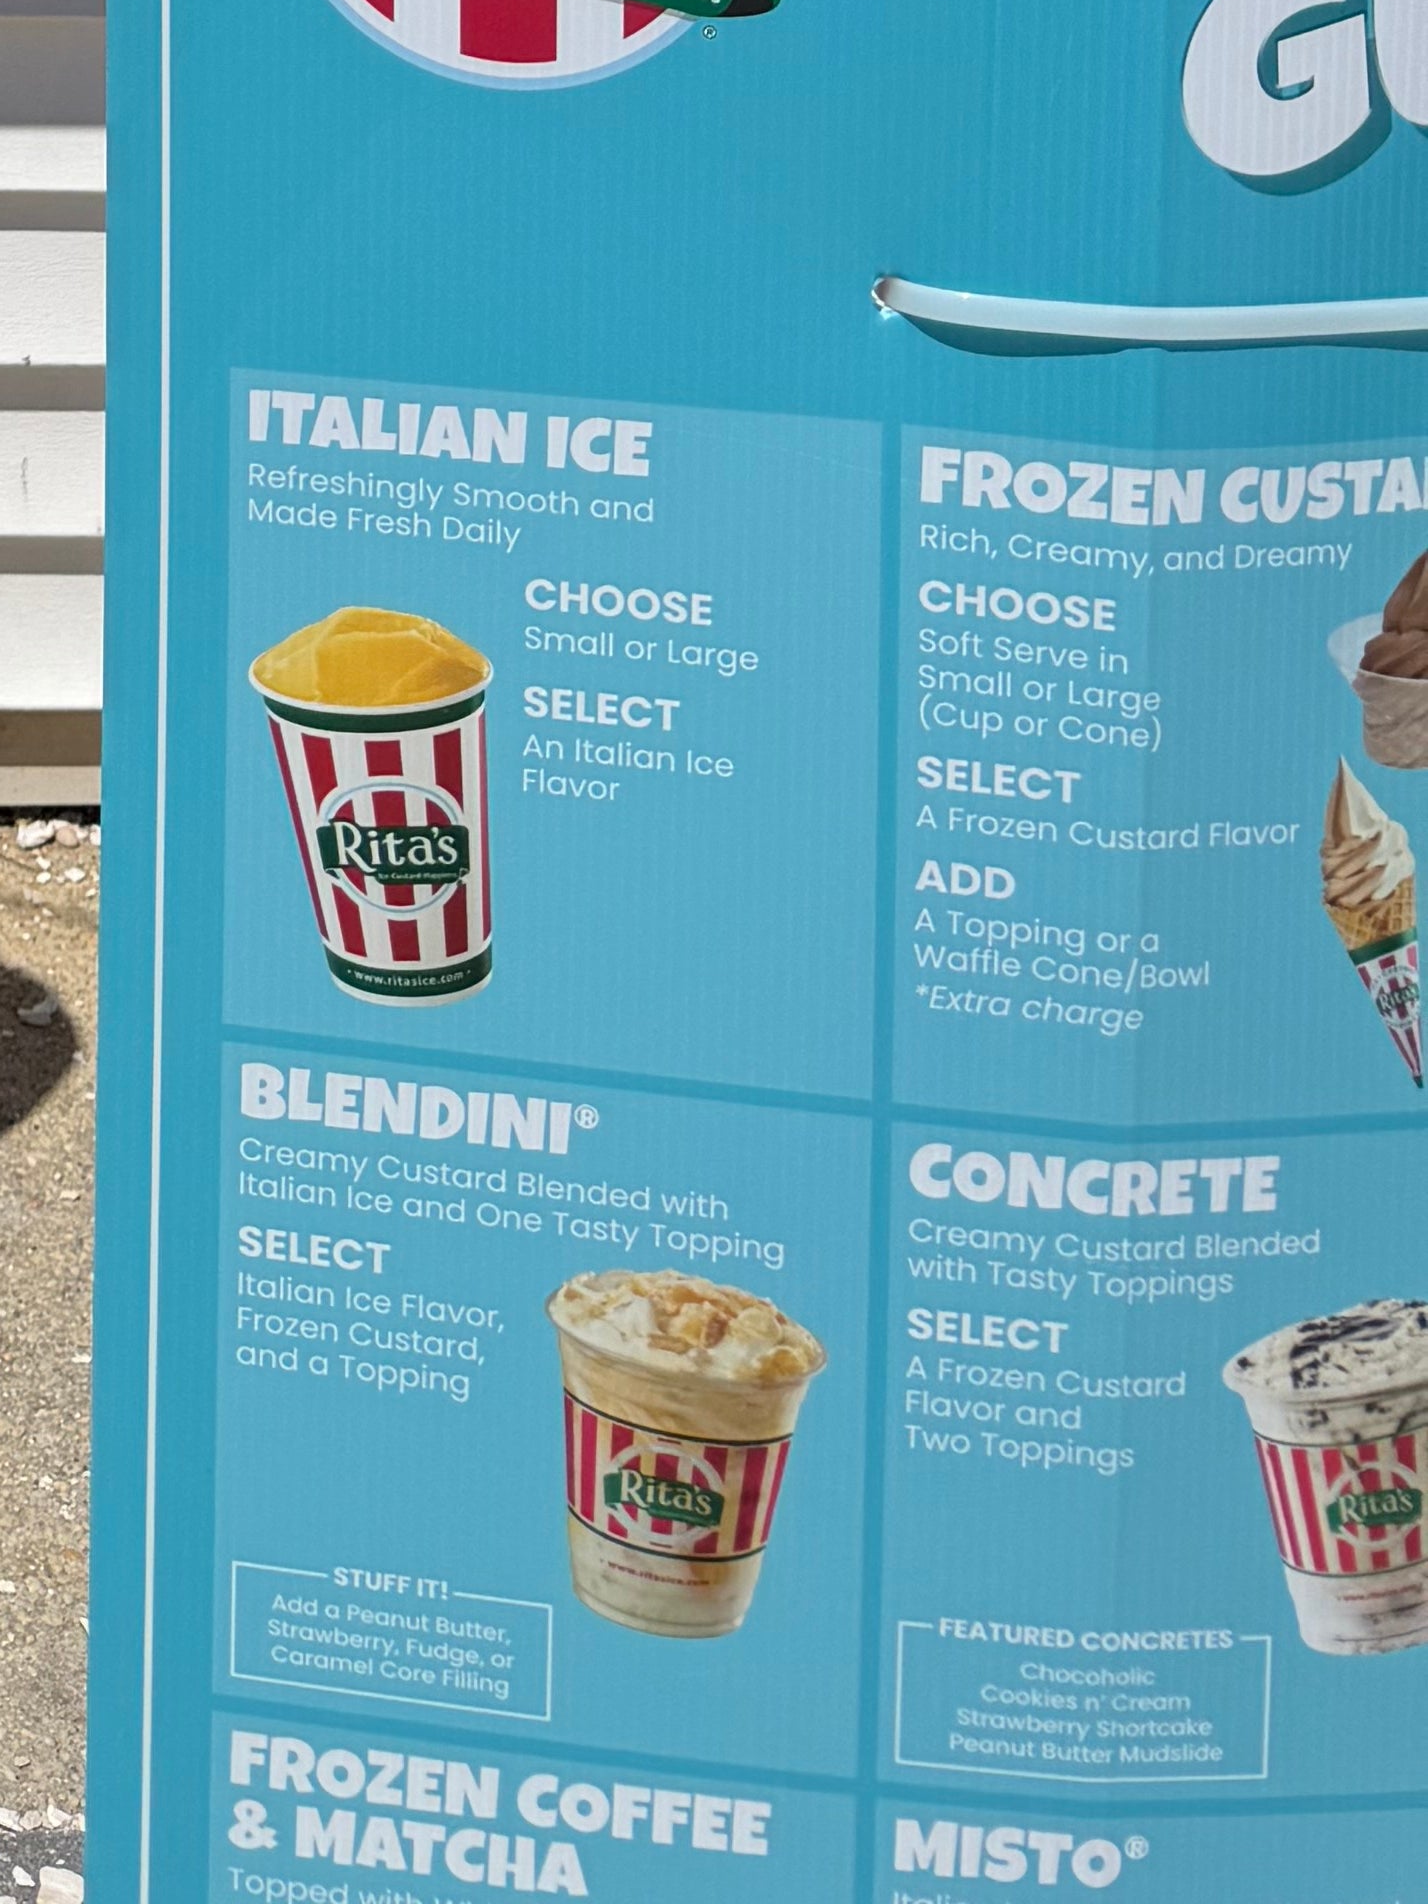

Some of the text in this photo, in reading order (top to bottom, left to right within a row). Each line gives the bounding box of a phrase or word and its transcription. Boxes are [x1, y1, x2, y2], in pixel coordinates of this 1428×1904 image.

[248, 390, 653, 476] ITALIAN ICE
[248, 464, 654, 522] Refreshingly Smooth and
[921, 446, 1428, 525] FROZEN CUSTA
[248, 499, 521, 553] Made Fresh Daily
[920, 525, 1352, 578] Rich, Creamy, and Dreamy
[524, 579, 712, 626] CHOOSE
[918, 580, 1116, 632] CHOOSE
[524, 626, 759, 676] Small or Large
[523, 686, 680, 731] SELECT
[917, 756, 1081, 803] SELECT
[334, 822, 458, 873] Rita's
[915, 860, 1016, 899] ADD
[914, 944, 1210, 993] Waffle Cone/Bowl
[1021, 994, 1143, 1037] charge
[239, 1138, 729, 1221] Creamy Custard Blended with
[909, 1143, 1280, 1217] CONCRETE
[239, 1171, 785, 1270] Italian Ice and One Tasty Topping
[908, 1218, 1320, 1262] Creamy Custard Blended
[238, 1226, 391, 1274] SELECT
[908, 1256, 1234, 1305] with Tasty Toppings
[907, 1308, 1069, 1354] SELECT
[621, 1469, 712, 1515] Rita's
[334, 1567, 449, 1600] STUFF IT!
[268, 1619, 514, 1668] Strawberry, Fudge, or
[272, 1594, 511, 1645] Add a Peanut Butter,
[940, 1618, 1233, 1652] FEATURED CONCRETES
[271, 1645, 509, 1700] Caramel Core Filling
[1020, 1662, 1156, 1686] Chocoholic
[981, 1684, 1077, 1710] Cookies
[1112, 1694, 1191, 1711] Cream
[949, 1733, 1223, 1764] Peanut Butter Mudslide
[956, 1708, 1213, 1742] Strawberry Shortcake
[228, 1730, 772, 1855] FROZEN COFFEE
[228, 1800, 587, 1897] & MATCHA
